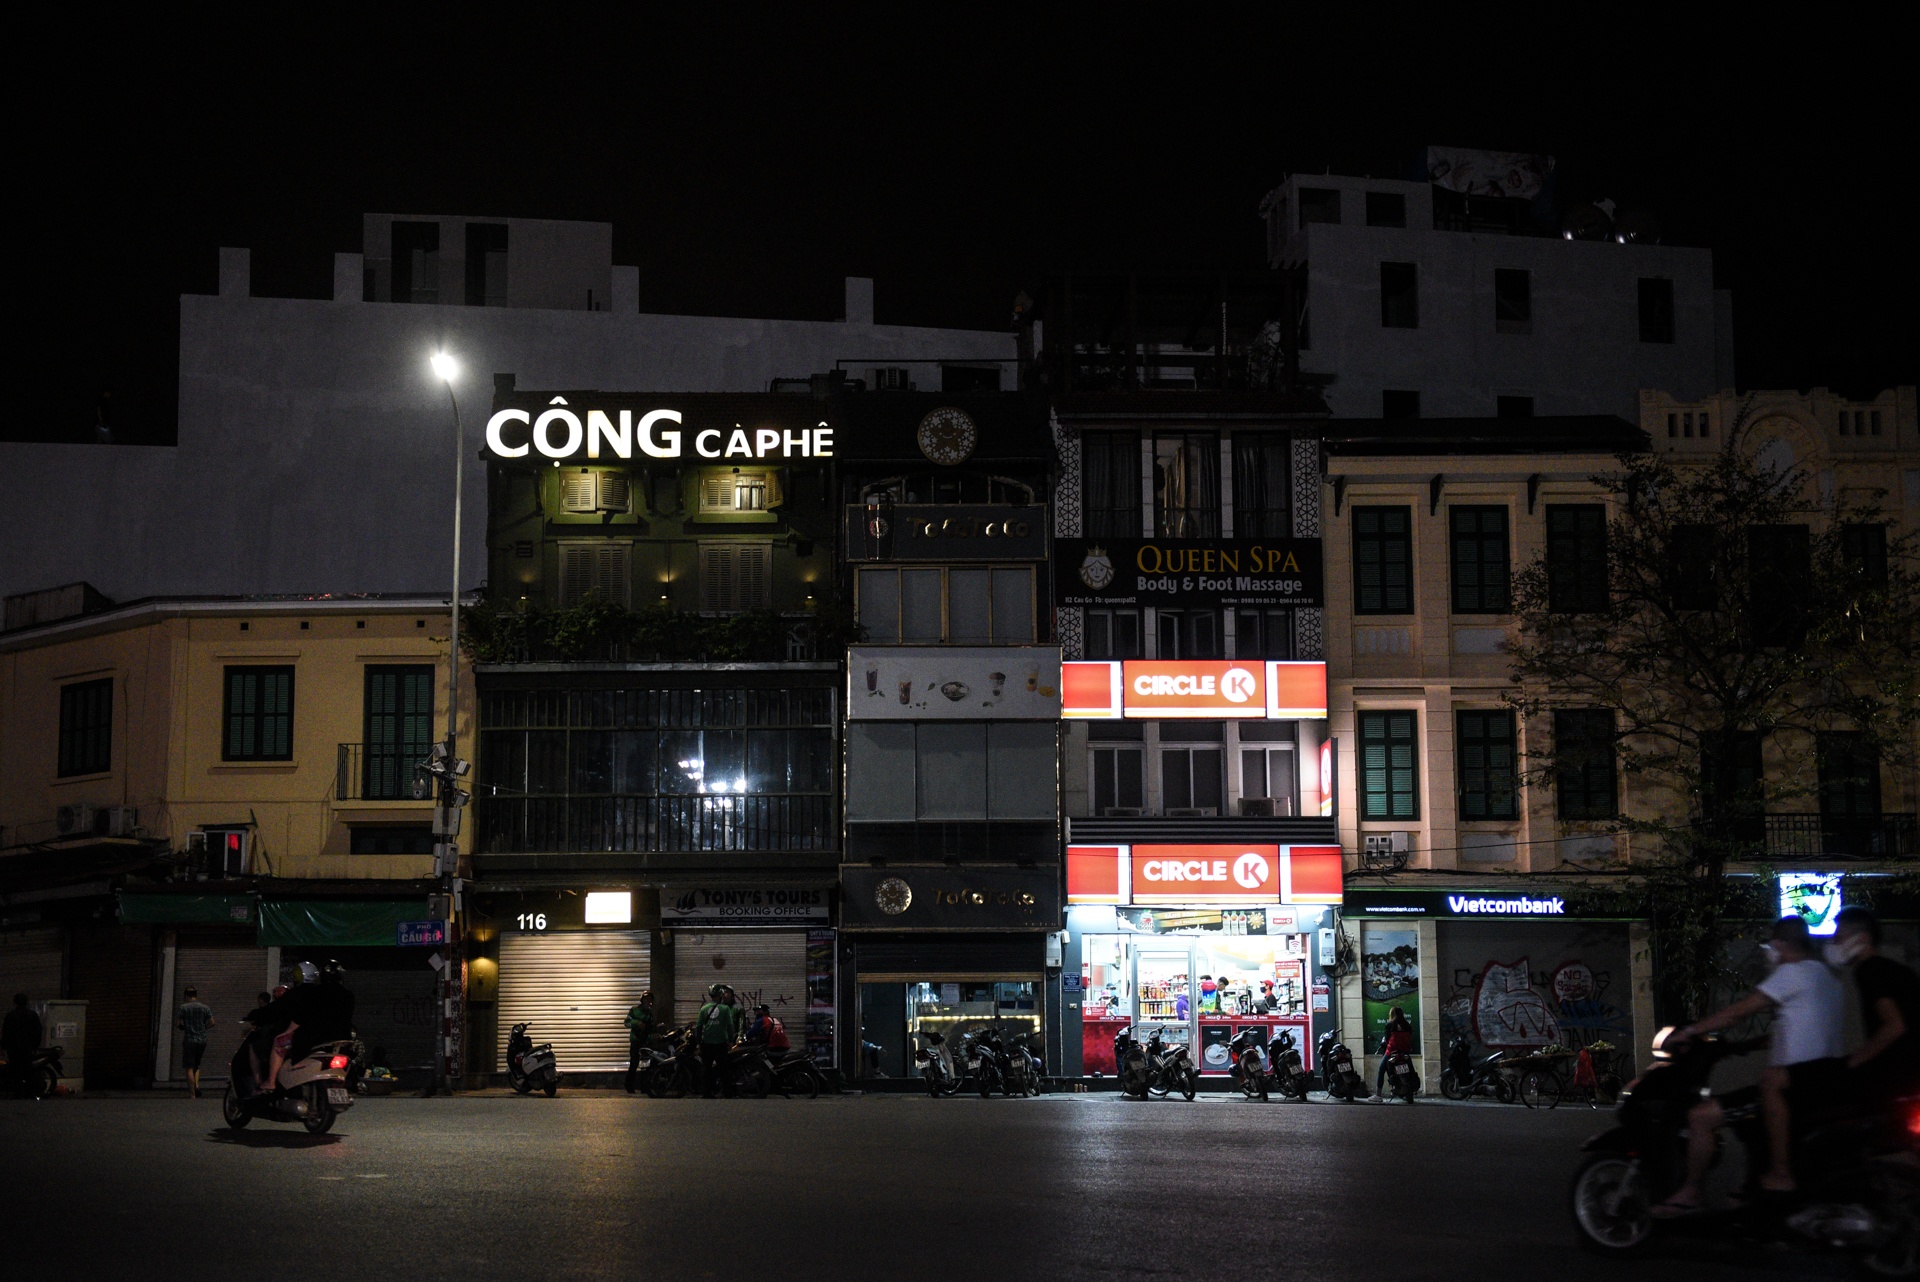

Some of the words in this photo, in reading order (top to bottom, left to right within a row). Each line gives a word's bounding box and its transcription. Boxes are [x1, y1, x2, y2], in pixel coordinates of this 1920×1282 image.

[486, 395, 682, 468] CỘNG
[1137, 545, 1239, 574] QUEEN
[1250, 545, 1302, 574] SPA
[1137, 576, 1177, 594] Body
[1183, 576, 1195, 591] &
[1199, 576, 1233, 591] Foot
[1236, 576, 1303, 594] Massage
[1133, 675, 1216, 696] CIRCLE
[1143, 860, 1227, 881] CIRCLE
[702, 890, 761, 904] TONY'S
[766, 890, 820, 904] TOURS
[1449, 896, 1564, 914] Vietcombank
[719, 907, 771, 916] BOOKING
[774, 907, 811, 915] OFFICE
[516, 913, 547, 930] 116
[1564, 970, 1581, 980] NO
